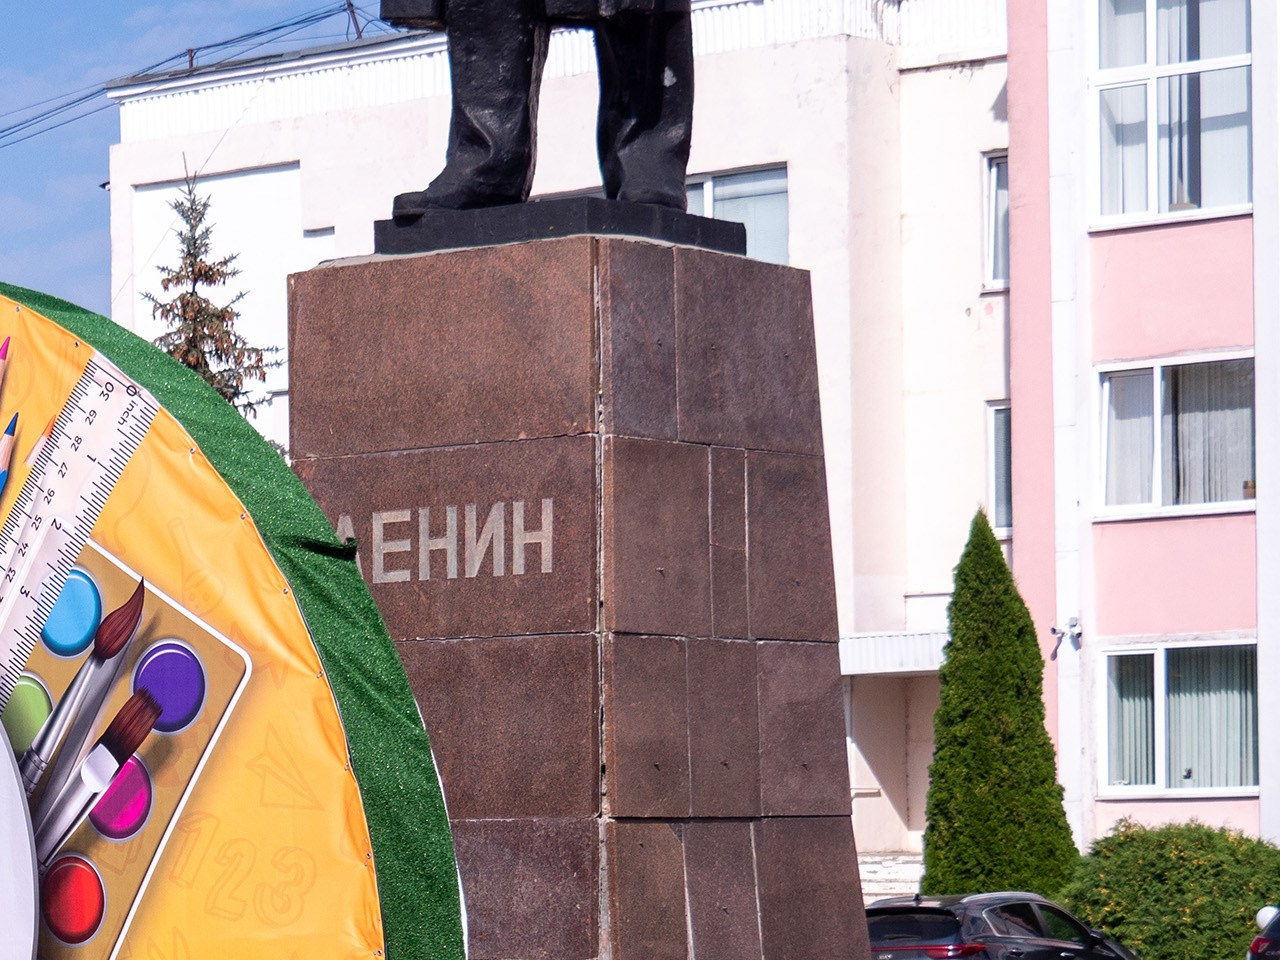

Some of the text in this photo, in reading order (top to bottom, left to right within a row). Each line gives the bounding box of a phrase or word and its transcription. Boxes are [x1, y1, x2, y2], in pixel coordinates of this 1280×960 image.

[118, 400, 139, 426] inch
[5, 567, 16, 583] 23
[18, 542, 29, 557] 24
[31, 515, 42, 531] 25
[43, 488, 55, 505] 26
[58, 462, 68, 478] 27
[70, 436, 82, 452] 28
[85, 410, 97, 425] 29
[99, 382, 114, 401] 30
[51, 518, 62, 530] 2
[20, 585, 30, 598] 3
